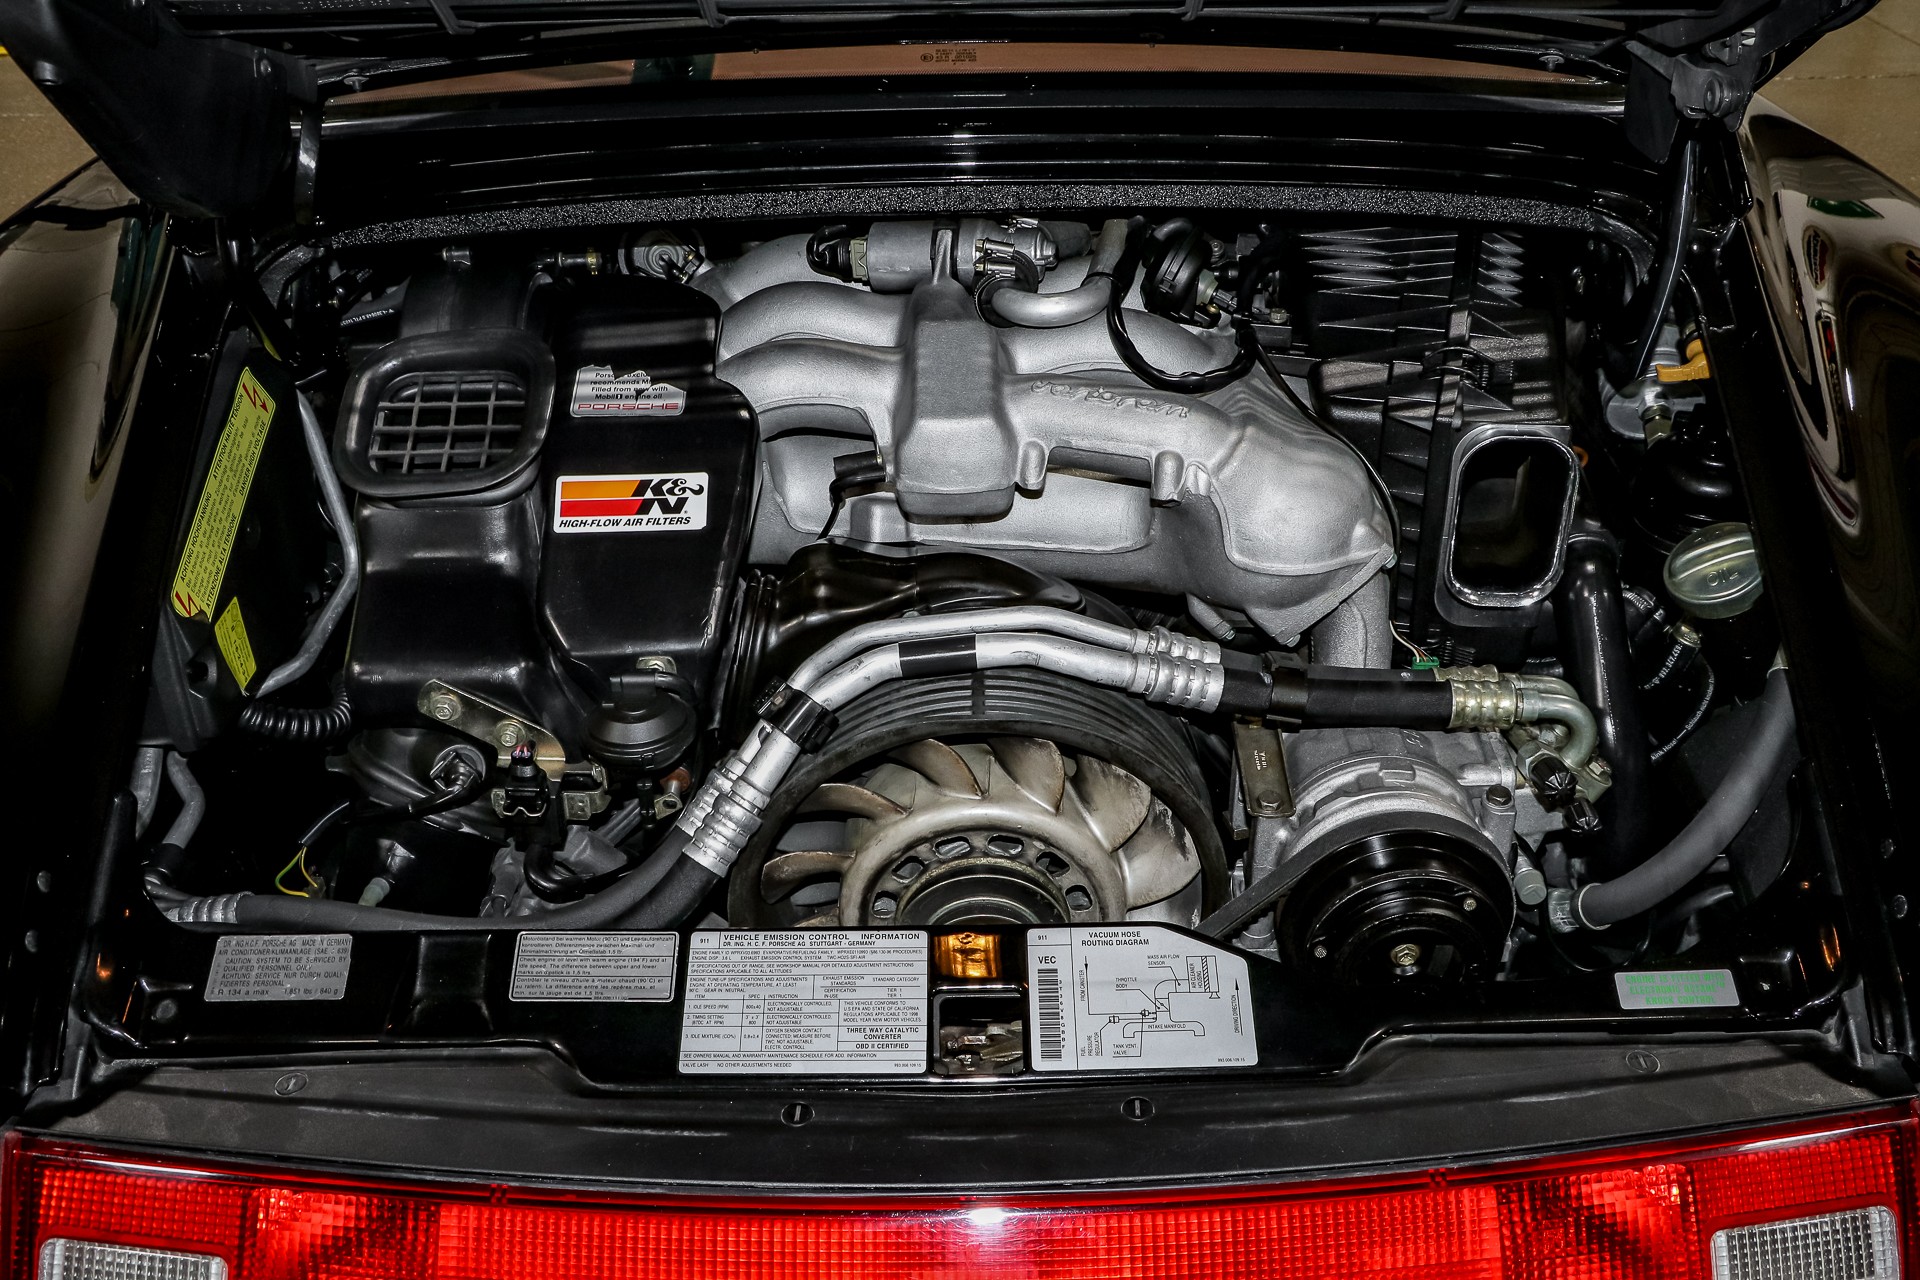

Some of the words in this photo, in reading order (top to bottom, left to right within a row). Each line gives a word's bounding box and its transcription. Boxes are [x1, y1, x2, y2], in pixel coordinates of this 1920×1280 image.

[211, 441, 228, 480] ATTENTION
[222, 420, 235, 443] HAUTE
[230, 392, 244, 421] TENSION
[237, 467, 251, 496] DANGER
[246, 449, 256, 467] HIGH
[252, 419, 267, 449] VOLTAGE
[631, 478, 704, 515] K&N
[178, 547, 194, 582] ACHTUNG
[189, 491, 212, 548] HOCHSPANNUNG
[559, 519, 623, 528] HIGH-FLOW
[623, 518, 643, 527] AIR
[646, 516, 691, 526] FILTERS
[204, 565, 222, 608] ATTENZIONE
[217, 546, 227, 565] ALTA
[222, 512, 237, 546] TENSIONE
[1707, 567, 1740, 588] OIL
[262, 939, 286, 947] PORSCHE
[327, 938, 351, 946] GERMANY
[1037, 956, 1057, 964] VEC
